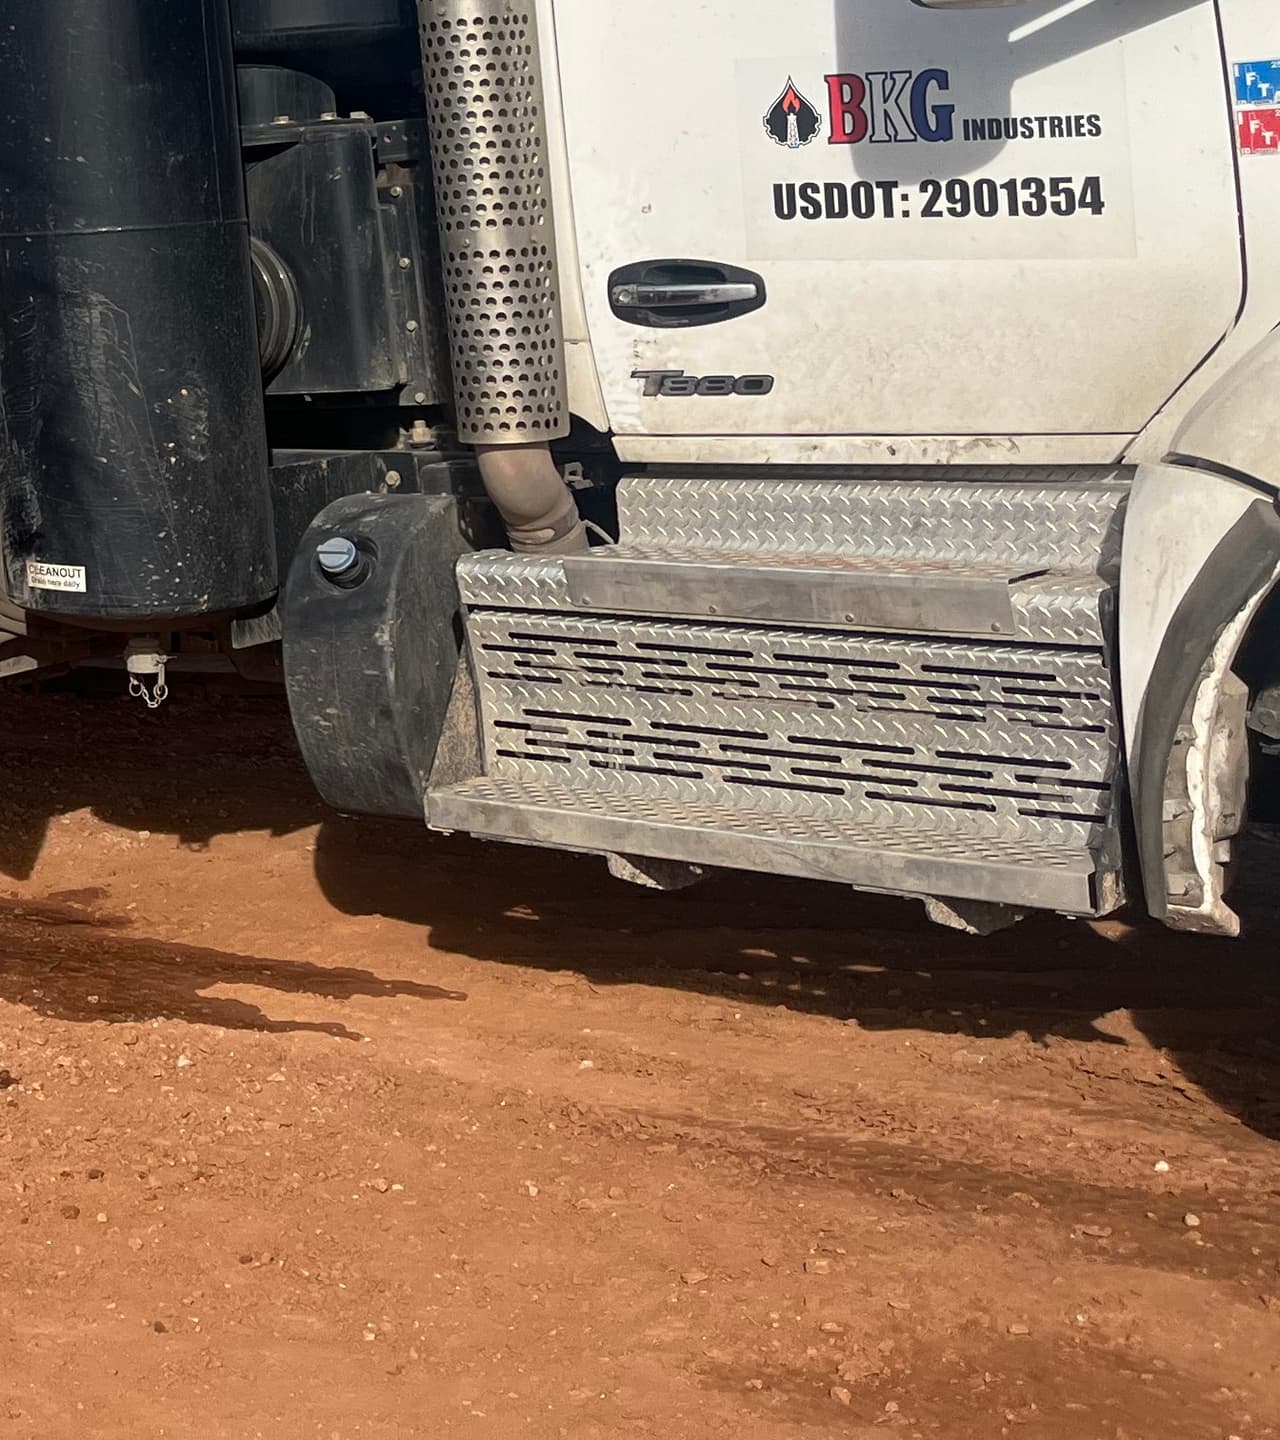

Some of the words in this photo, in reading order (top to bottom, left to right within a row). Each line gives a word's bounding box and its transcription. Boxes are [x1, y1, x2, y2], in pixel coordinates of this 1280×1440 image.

[824, 68, 955, 145] BKG
[962, 114, 1102, 141] INDUSTRIES
[773, 180, 910, 220] USDOT:
[920, 176, 1105, 218] 2901354
[630, 370, 775, 397] T880
[28, 564, 81, 578] CLEANOUT
